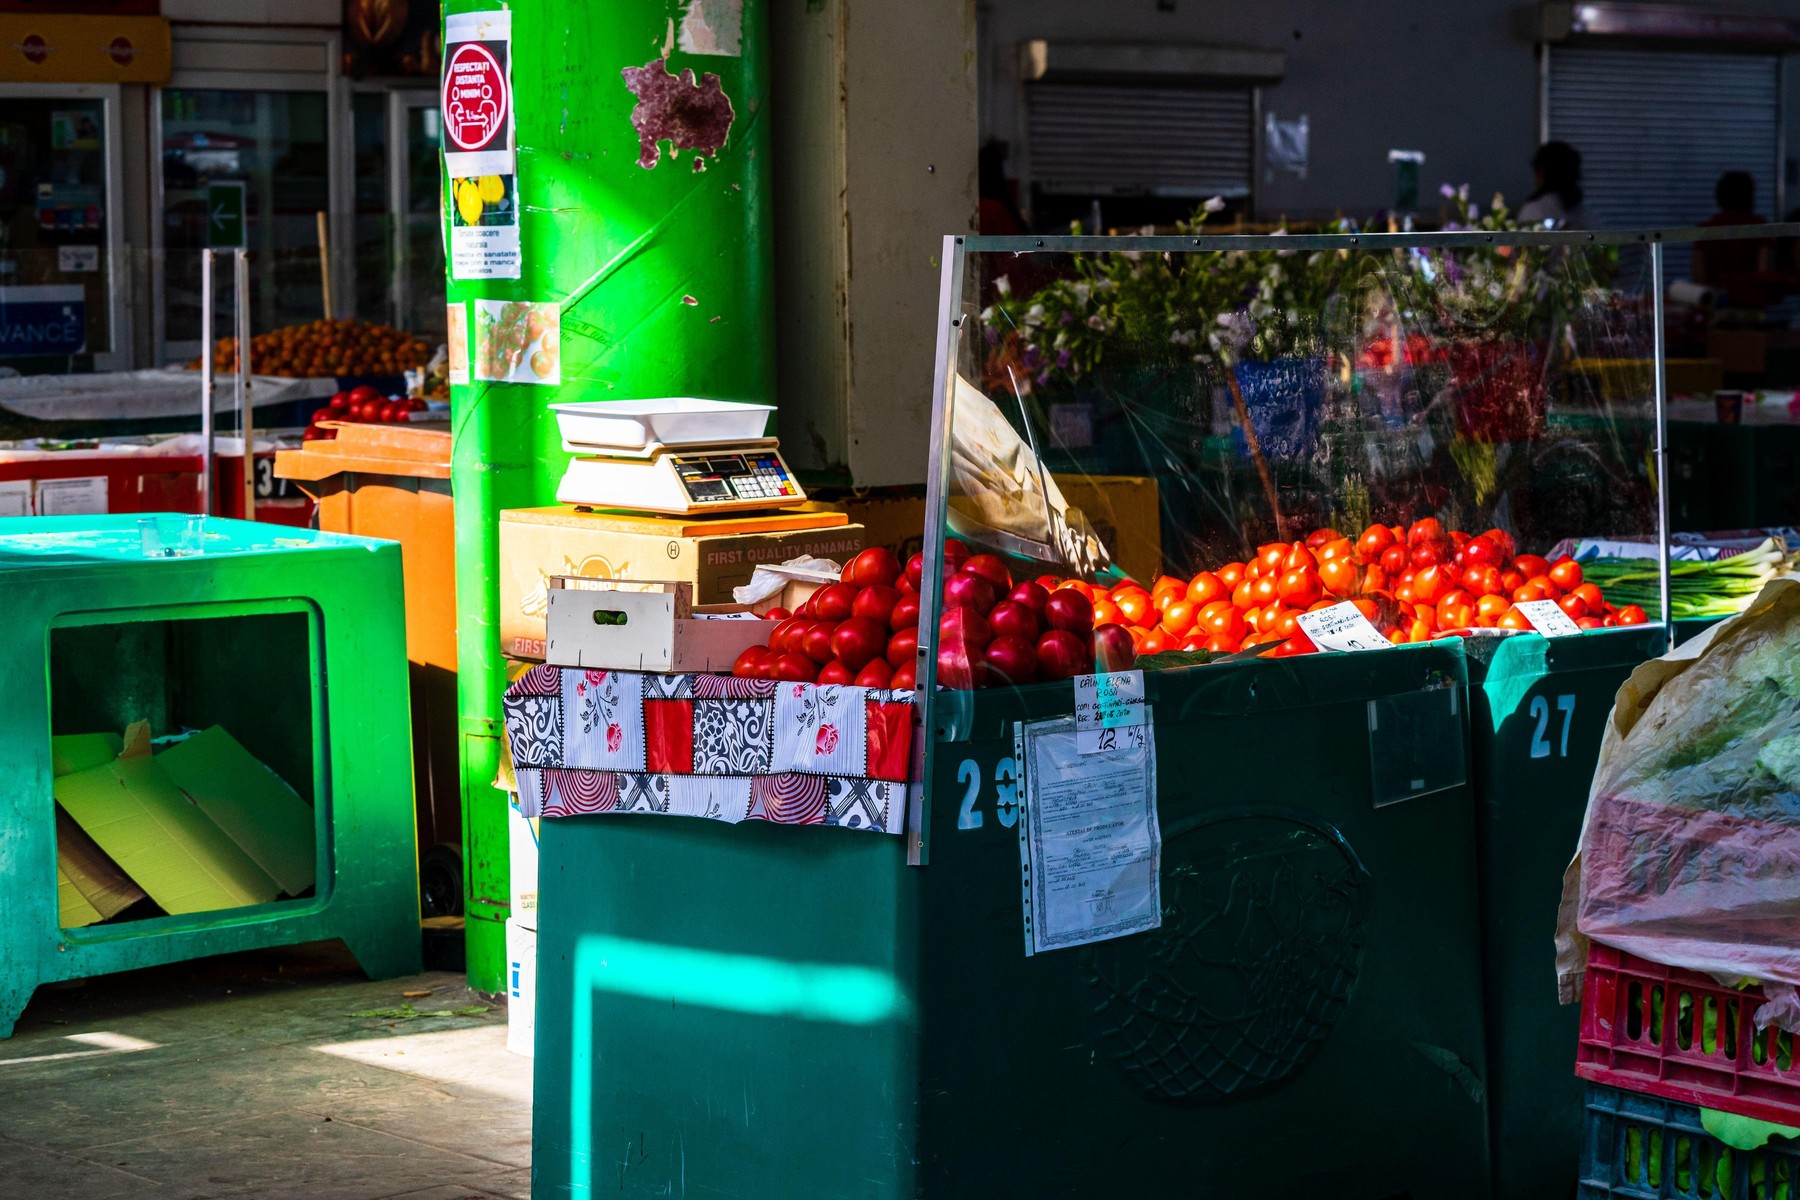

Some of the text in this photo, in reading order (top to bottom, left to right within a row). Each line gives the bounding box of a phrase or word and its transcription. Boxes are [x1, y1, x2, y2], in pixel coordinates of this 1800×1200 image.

[707, 538, 861, 566] FIRST QUALITY BANANAS
[514, 637, 546, 656] FIRST
[1105, 676, 1132, 687] ELENA
[1530, 694, 1575, 758] 27
[957, 757, 1018, 830] 28
